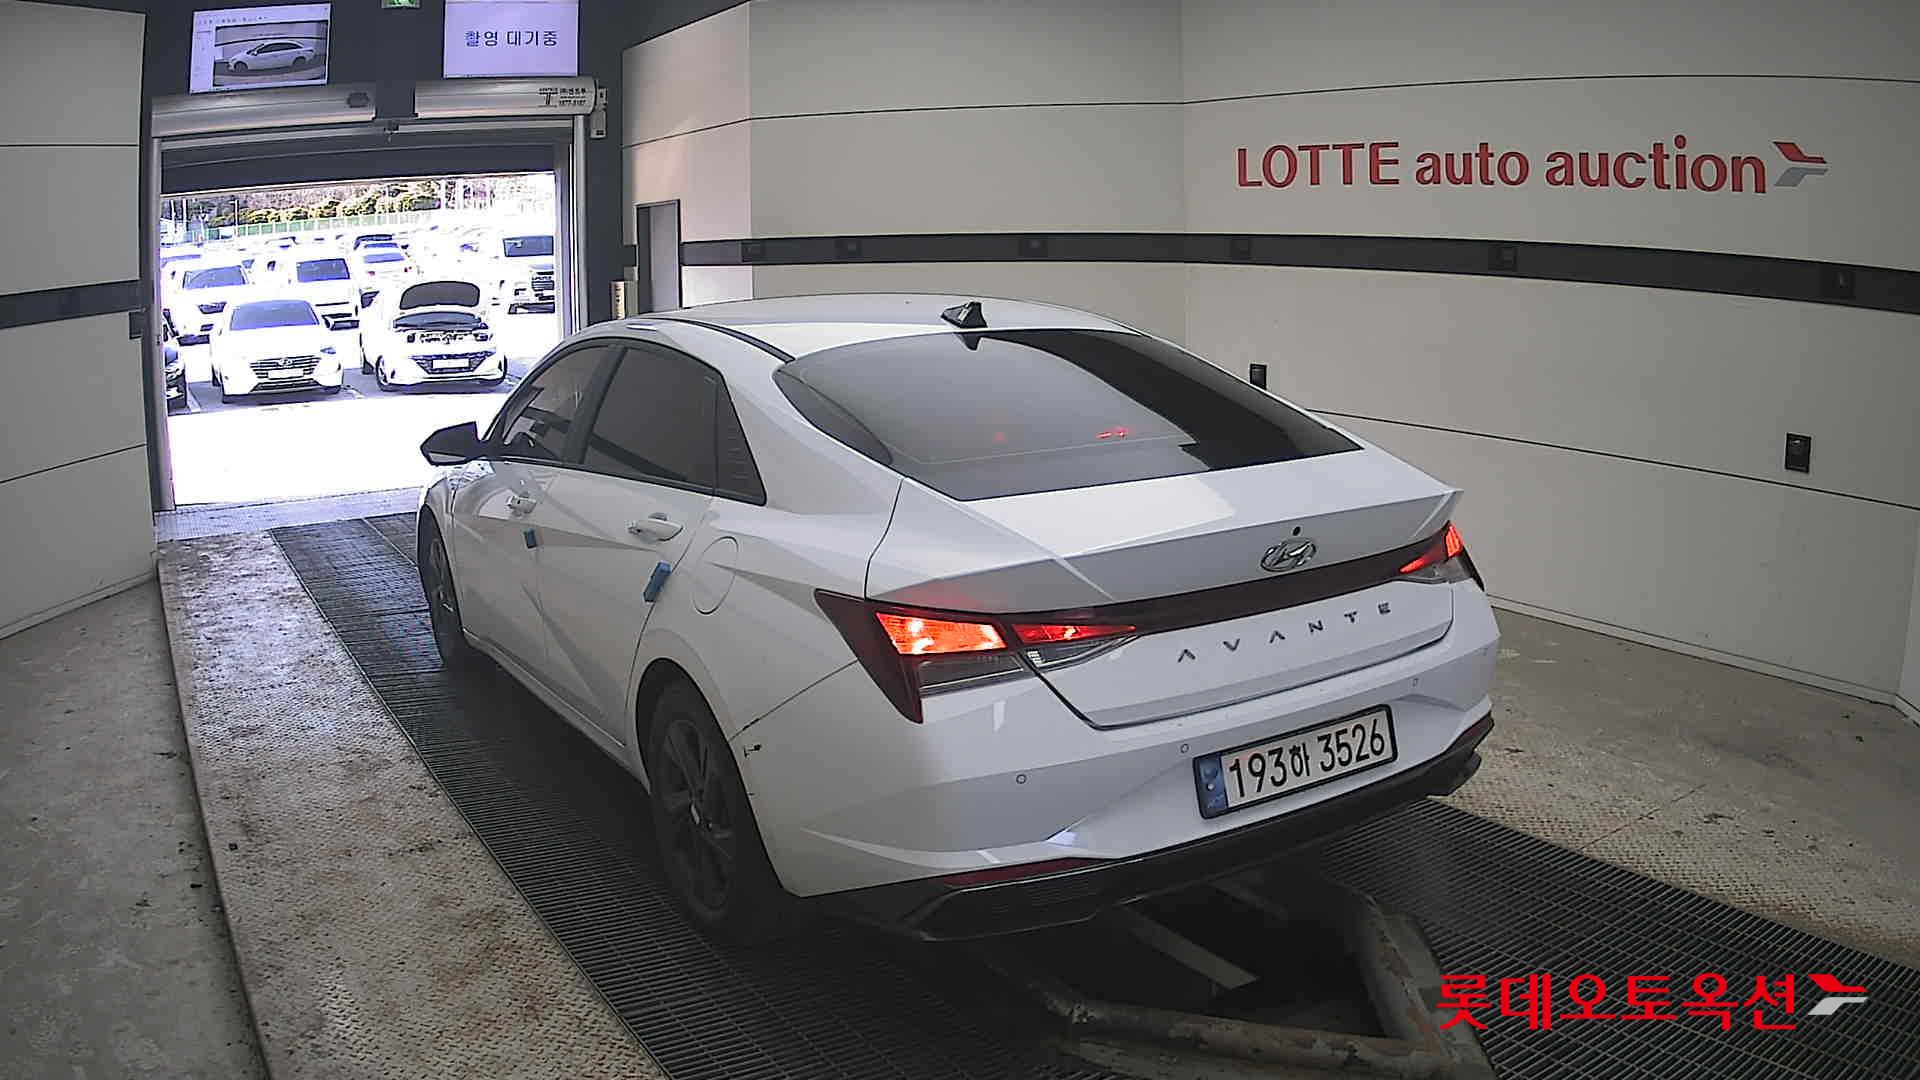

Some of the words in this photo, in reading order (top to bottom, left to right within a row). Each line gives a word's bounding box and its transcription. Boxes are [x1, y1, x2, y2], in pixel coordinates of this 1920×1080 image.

[465, 31, 498, 47] 촬영
[507, 31, 557, 47] 대기중
[1236, 143, 1400, 188] LOTTE
[1415, 143, 1531, 186] auto
[1545, 135, 1767, 193] auction
[1177, 602, 1392, 663] AVANTE
[1229, 743, 1310, 798] 193하
[1317, 719, 1385, 772] 3526
